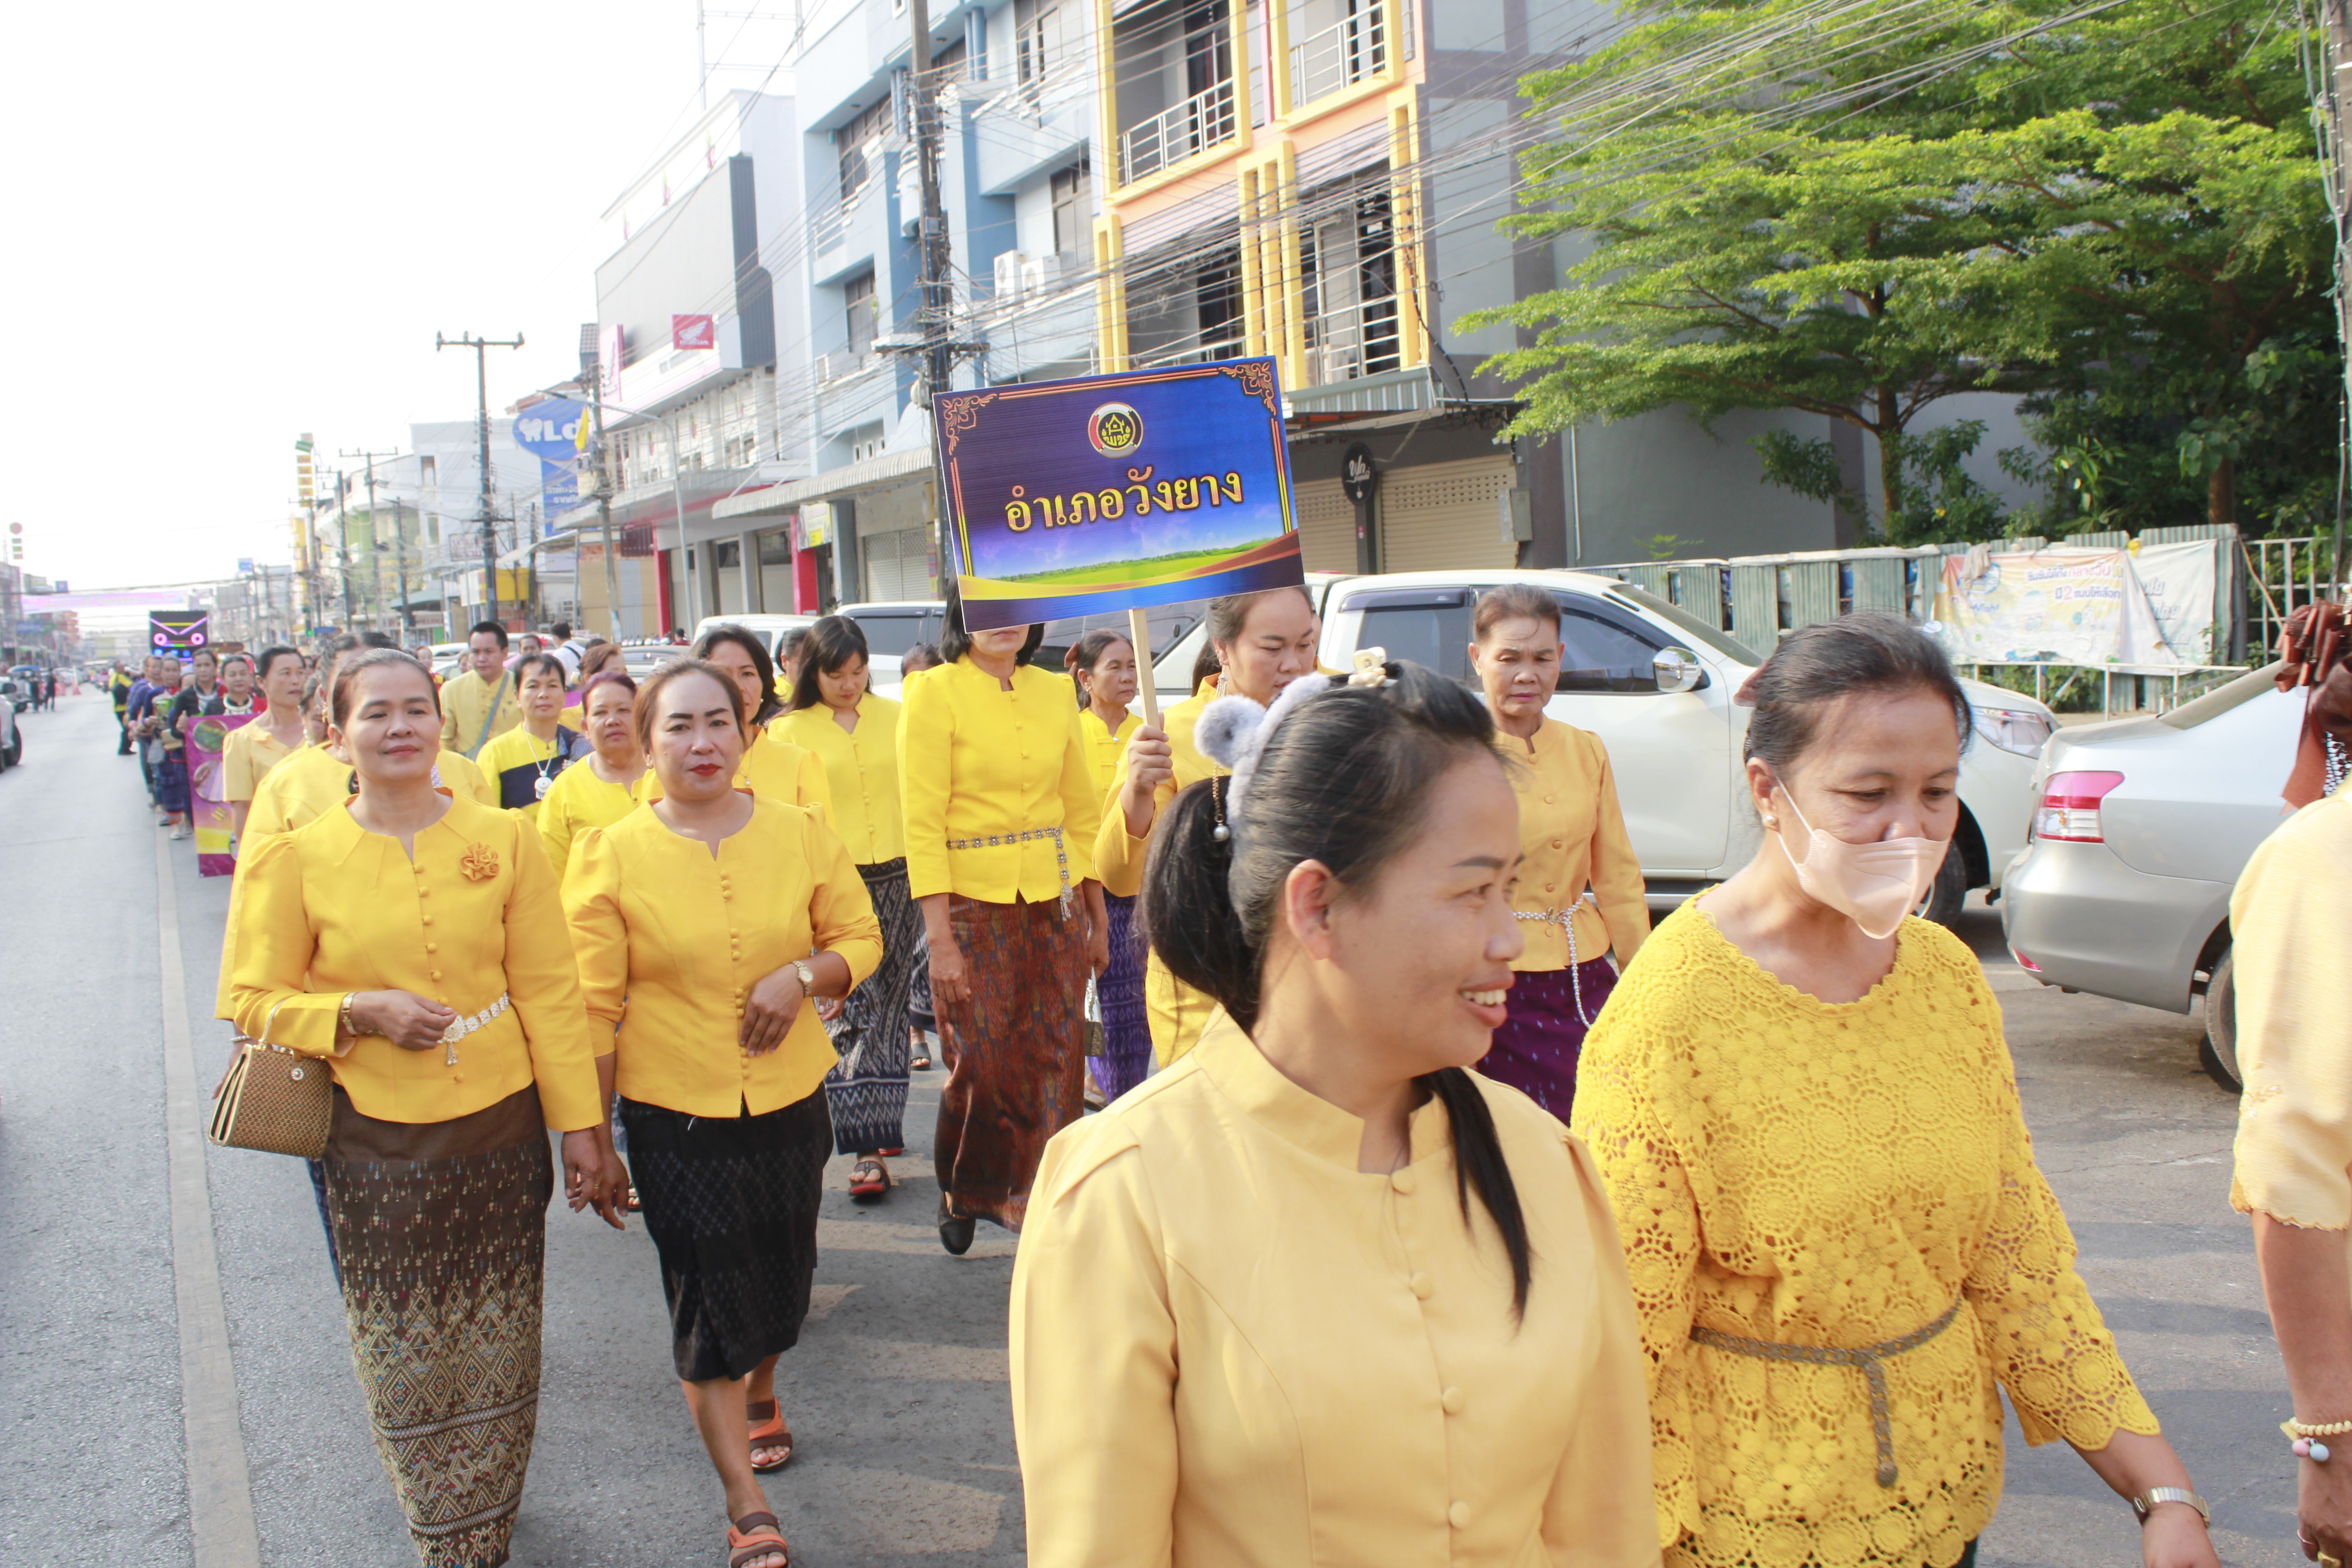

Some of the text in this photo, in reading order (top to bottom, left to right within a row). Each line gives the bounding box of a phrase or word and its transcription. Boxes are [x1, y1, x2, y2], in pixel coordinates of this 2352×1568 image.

[1004, 466, 1243, 532] อำเภอวังยาง
[2055, 587, 2063, 599] มี
[2064, 585, 2073, 599] 2
